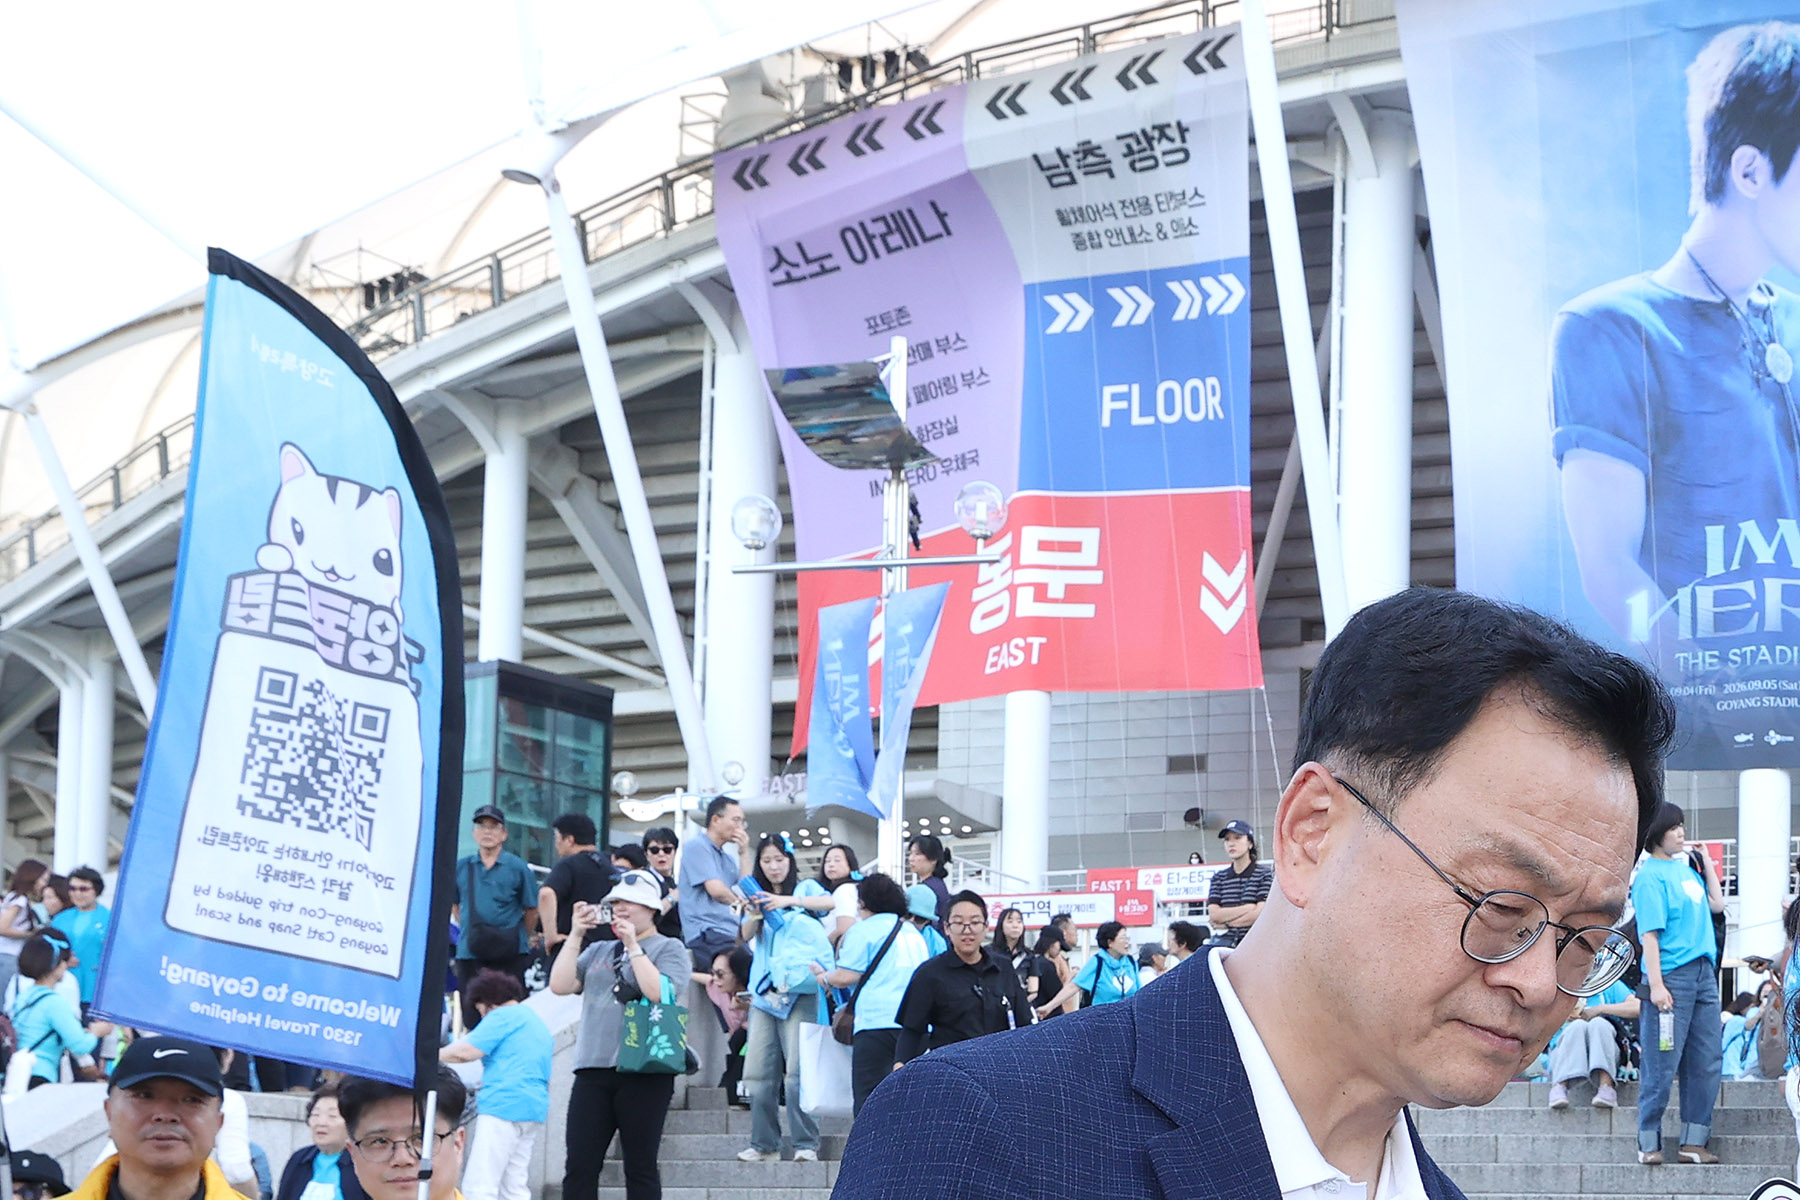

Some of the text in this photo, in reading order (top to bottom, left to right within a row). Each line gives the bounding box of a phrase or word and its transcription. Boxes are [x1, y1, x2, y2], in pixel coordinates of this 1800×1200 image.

[1033, 121, 1192, 189] 남측 광장
[769, 200, 955, 287] 소노 아레나
[1155, 222, 1170, 241] &
[864, 305, 913, 337] 포토존
[934, 331, 969, 355] 부스
[912, 366, 991, 405] 페어링 부스
[1100, 375, 1226, 429] FLOOR
[915, 415, 960, 444] 화장실
[939, 449, 981, 477] 우체국
[983, 636, 1048, 675] EAST
[1674, 649, 1720, 673] THE
[1716, 698, 1760, 712] GOYANG
